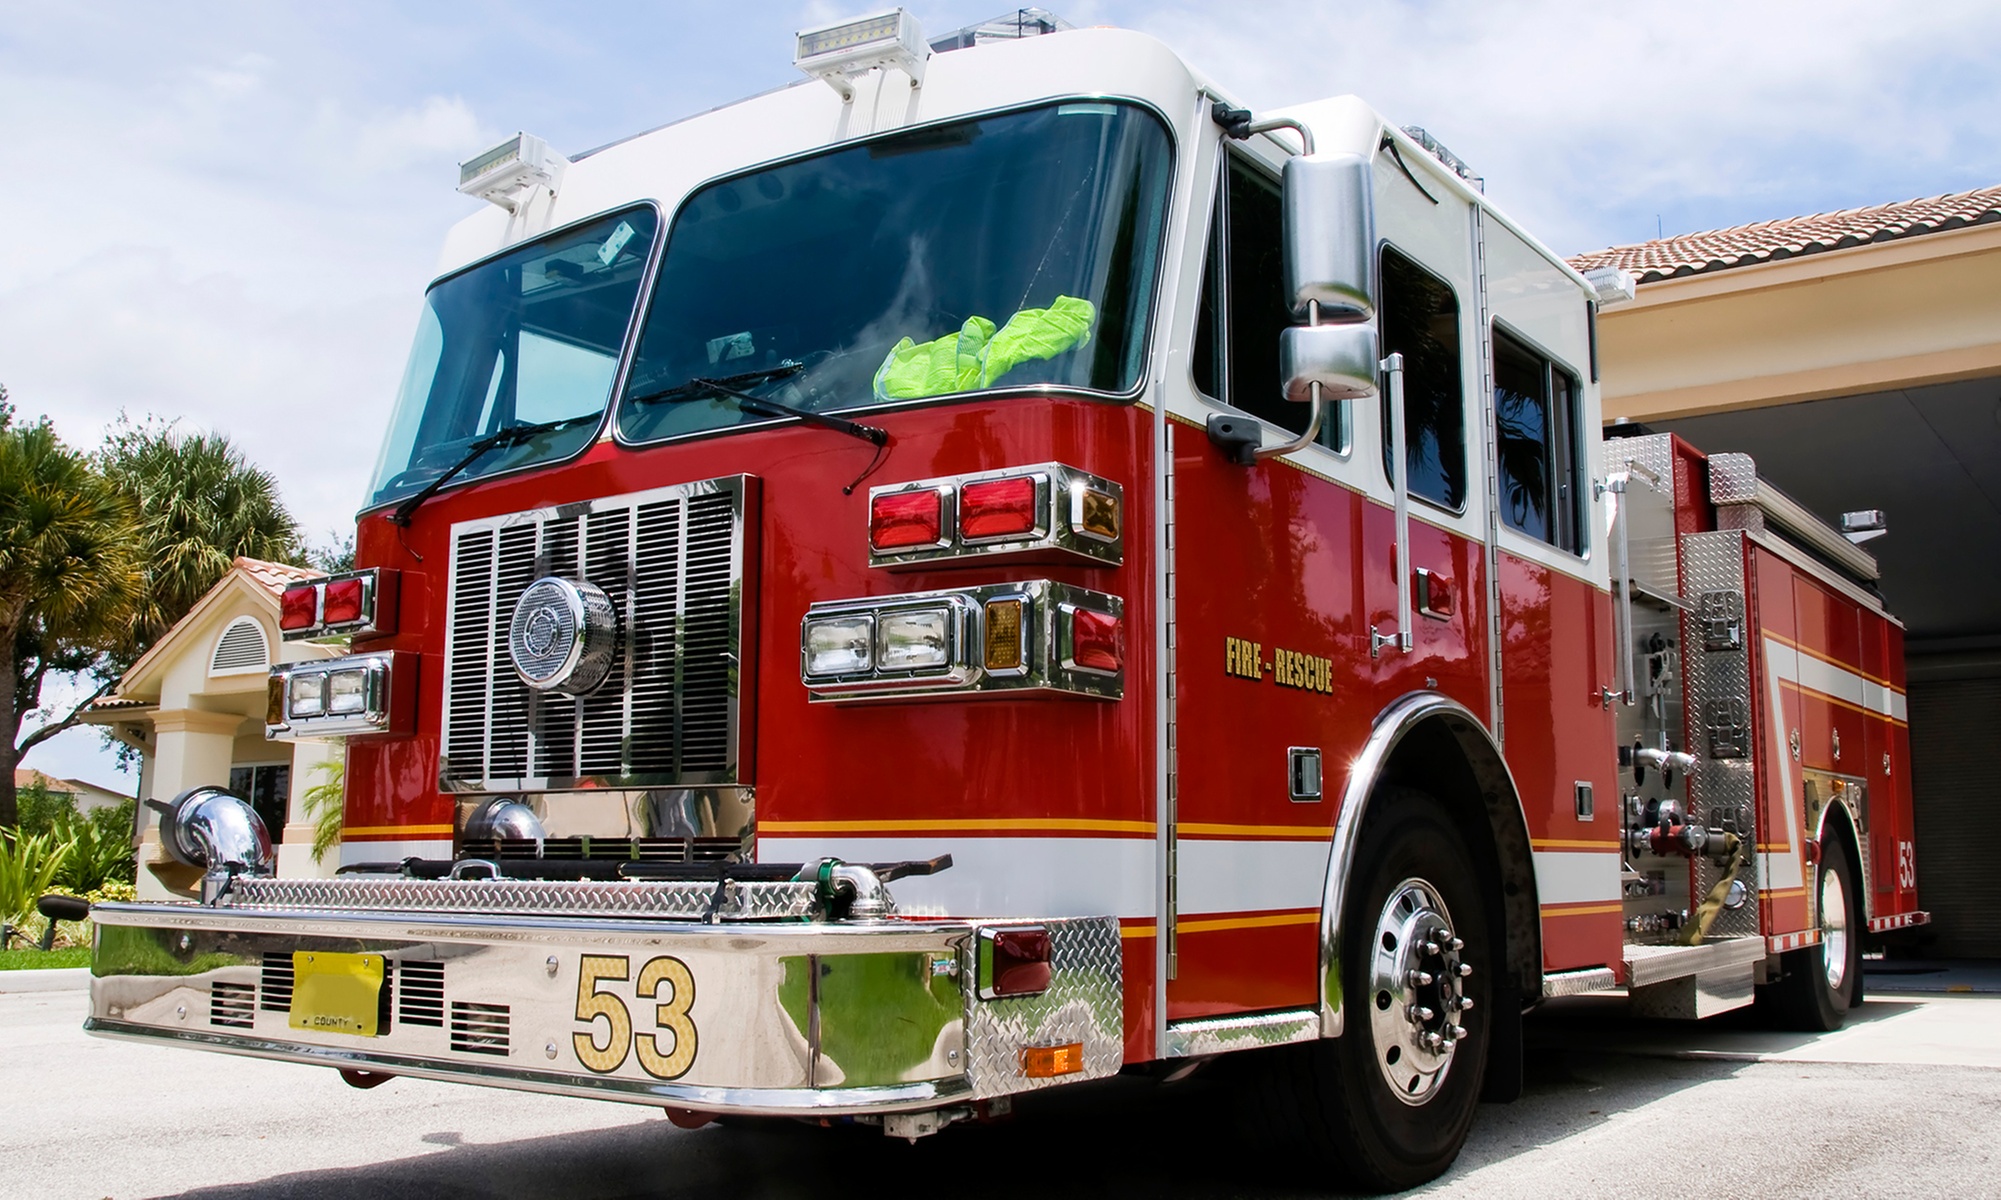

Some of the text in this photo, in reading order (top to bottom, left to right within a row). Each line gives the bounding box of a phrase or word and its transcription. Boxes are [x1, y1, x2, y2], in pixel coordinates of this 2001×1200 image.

[1226, 636, 1262, 680] FIRE
[1274, 647, 1333, 694] RESCUE
[1900, 841, 1914, 888] 53
[314, 1016, 349, 1026] COUNTY
[572, 953, 698, 1081] 53
